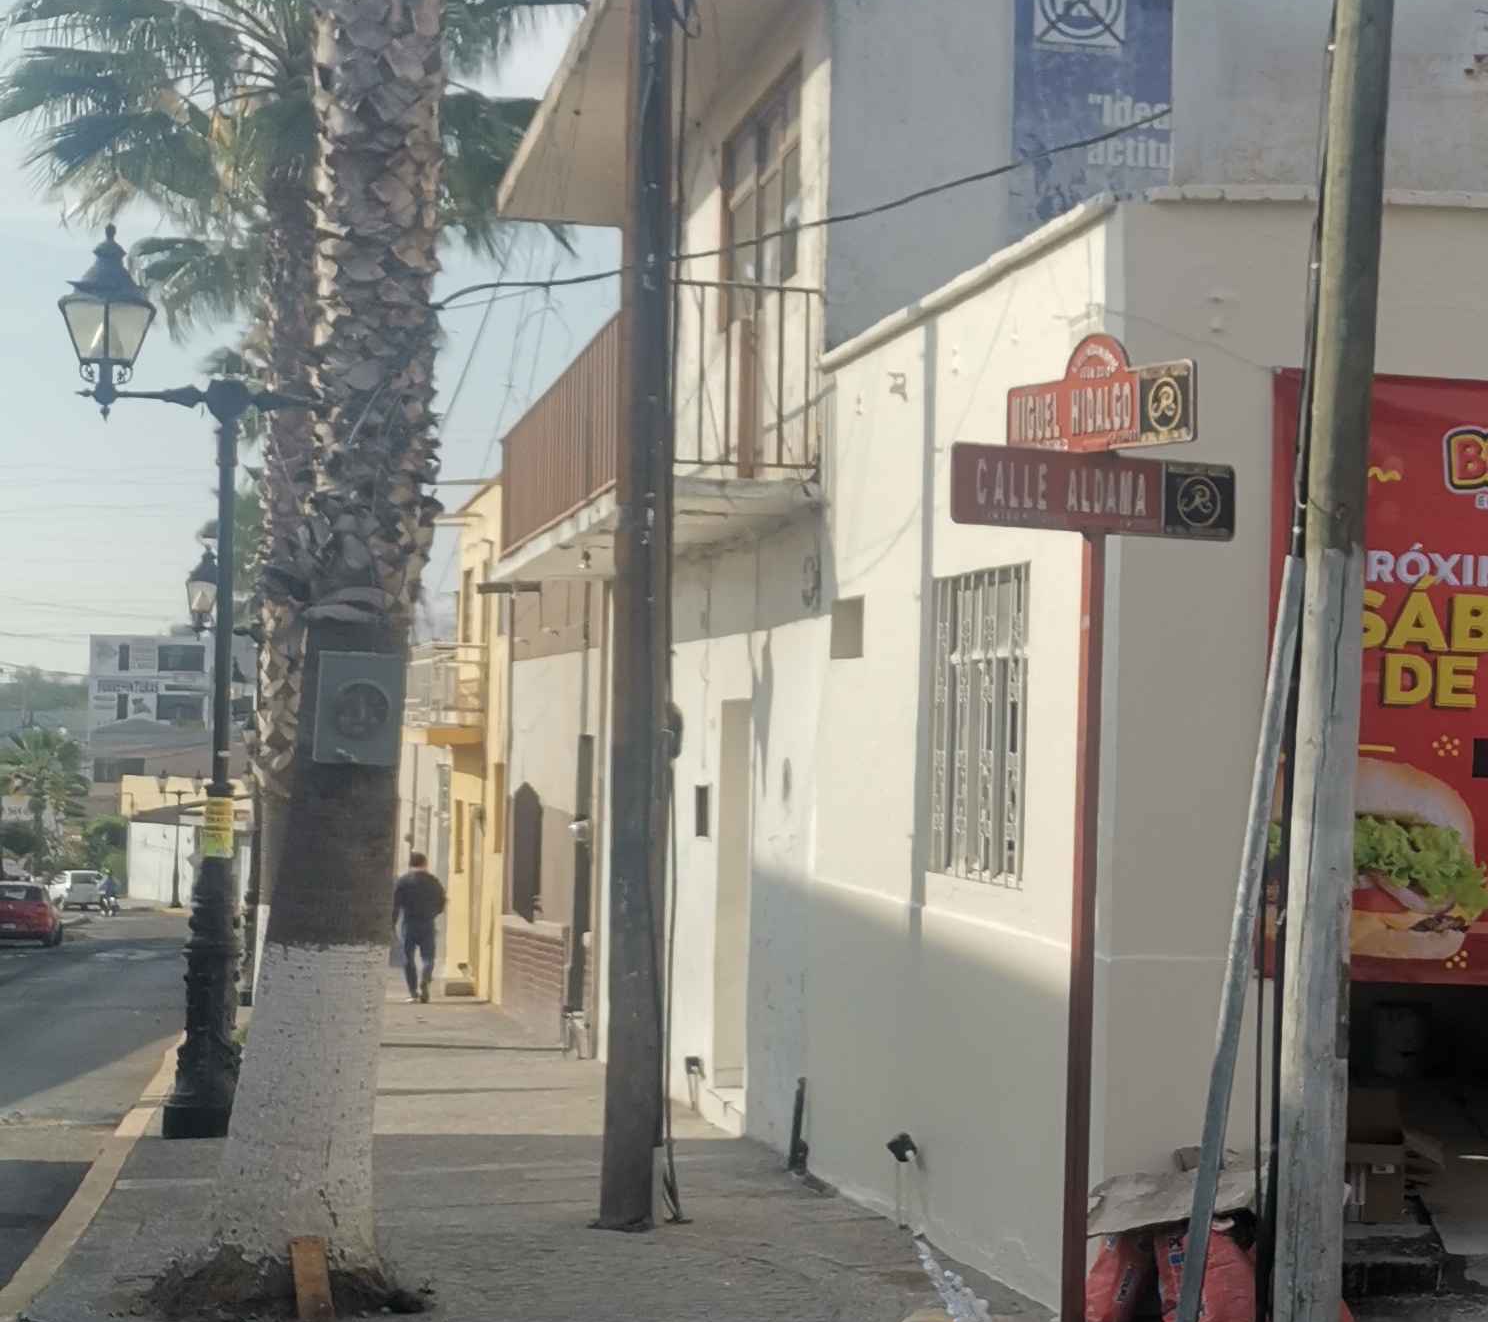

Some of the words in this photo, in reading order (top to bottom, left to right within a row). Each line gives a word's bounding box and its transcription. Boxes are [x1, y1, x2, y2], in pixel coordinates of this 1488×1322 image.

[1011, 391, 1060, 443] MIGUEL
[1070, 381, 1132, 438] HIDALGO
[975, 457, 1048, 511] CALLE
[1065, 468, 1147, 517] ALDAMA
[1380, 652, 1478, 710] DE
